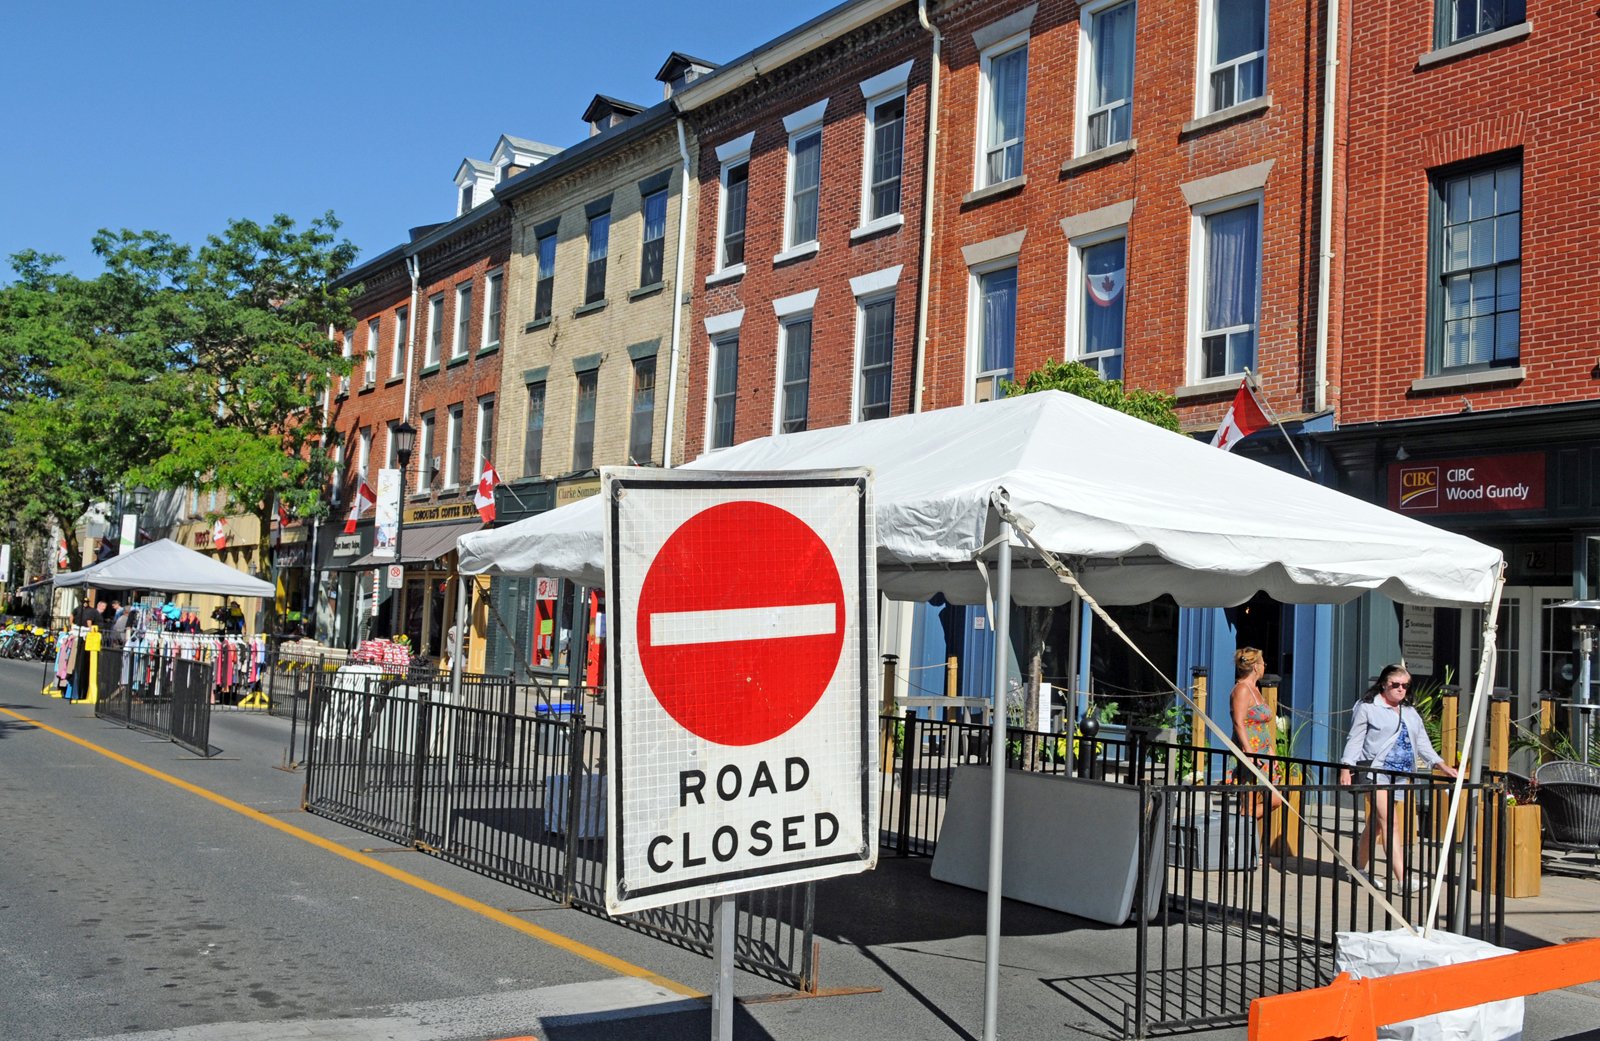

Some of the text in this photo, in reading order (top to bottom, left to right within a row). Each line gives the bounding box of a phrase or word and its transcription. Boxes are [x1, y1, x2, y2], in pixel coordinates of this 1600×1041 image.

[1403, 471, 1436, 487] CIBC
[1446, 468, 1475, 482] CIBC
[1446, 482, 1529, 500] Wood Gundy
[679, 756, 810, 807] ROAD
[647, 812, 840, 873] CLOSED
